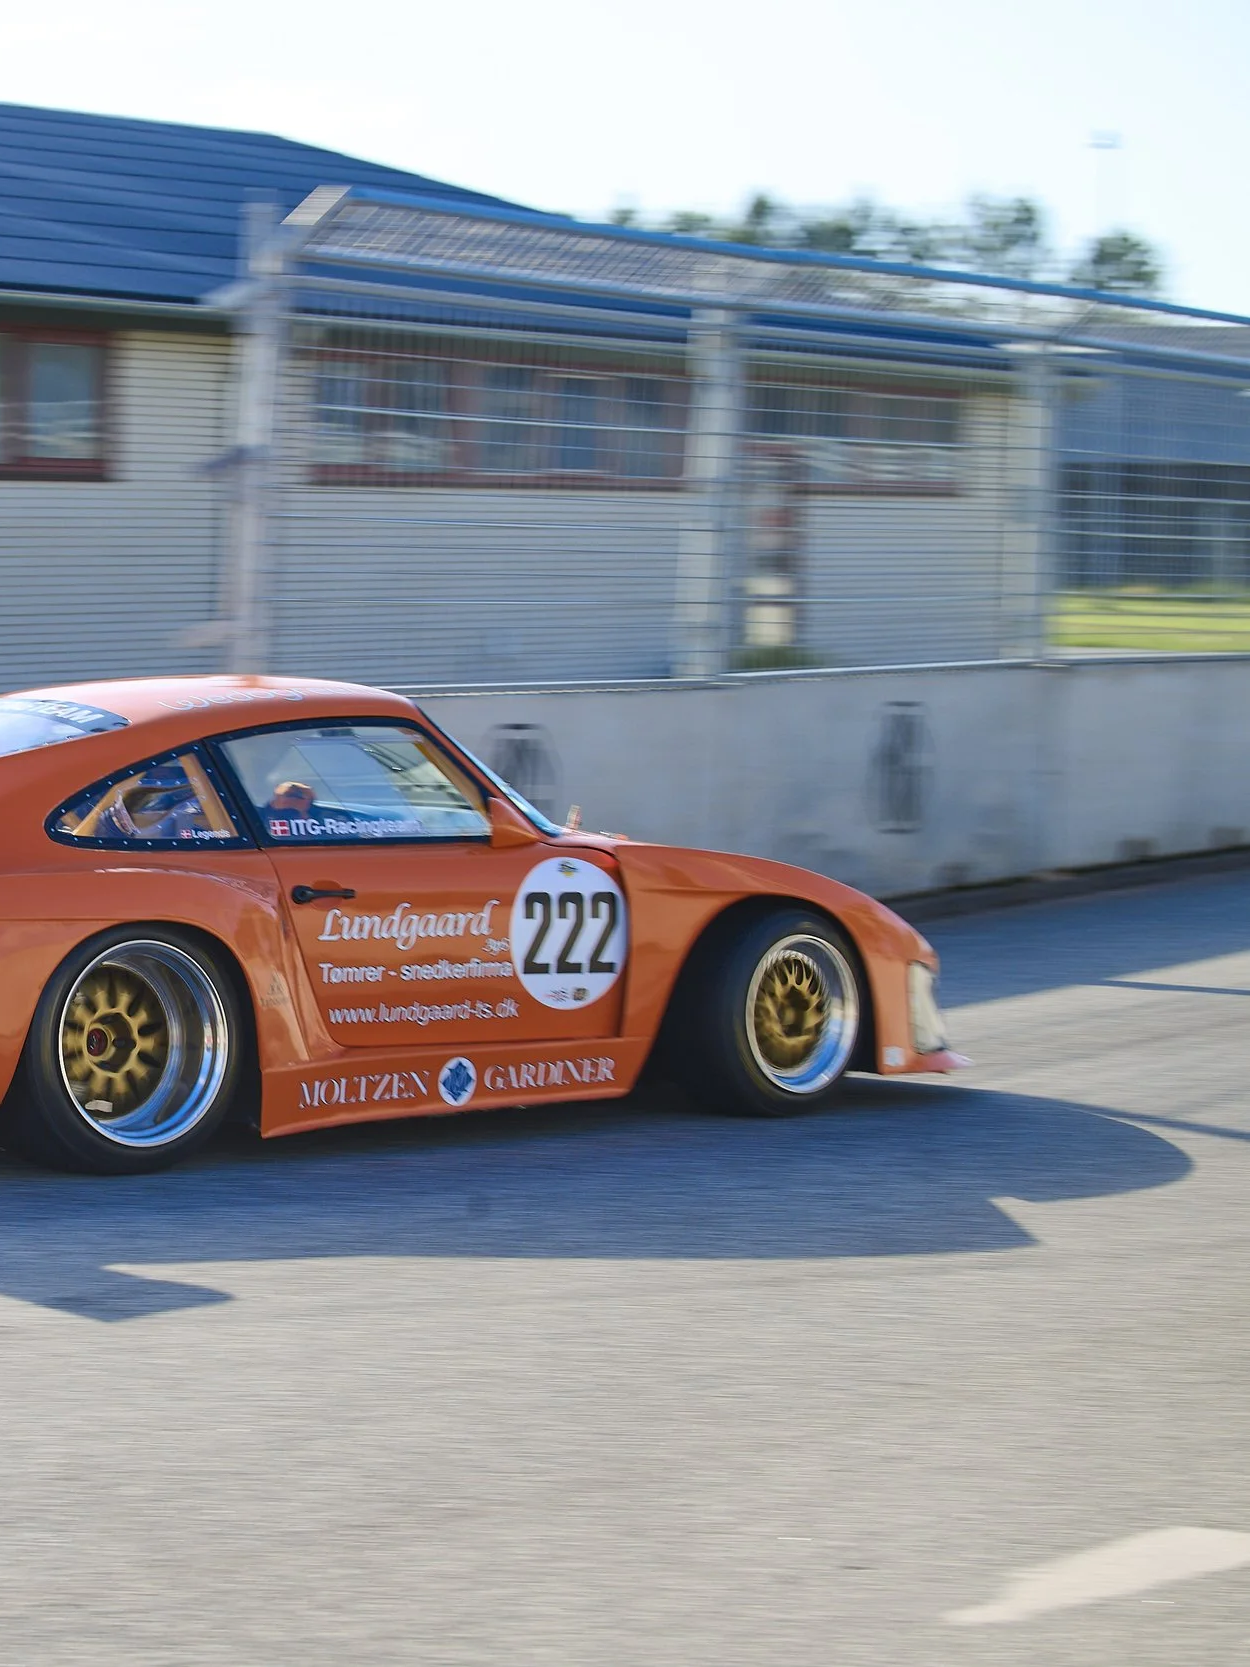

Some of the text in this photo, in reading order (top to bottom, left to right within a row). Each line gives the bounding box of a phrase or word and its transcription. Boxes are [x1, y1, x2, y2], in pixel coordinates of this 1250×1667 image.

[317, 899, 501, 951] Lundgaard
[523, 891, 617, 975] 222
[318, 962, 386, 985] Tømrer
[298, 1056, 616, 1109] MOLTZEN GARDINER
